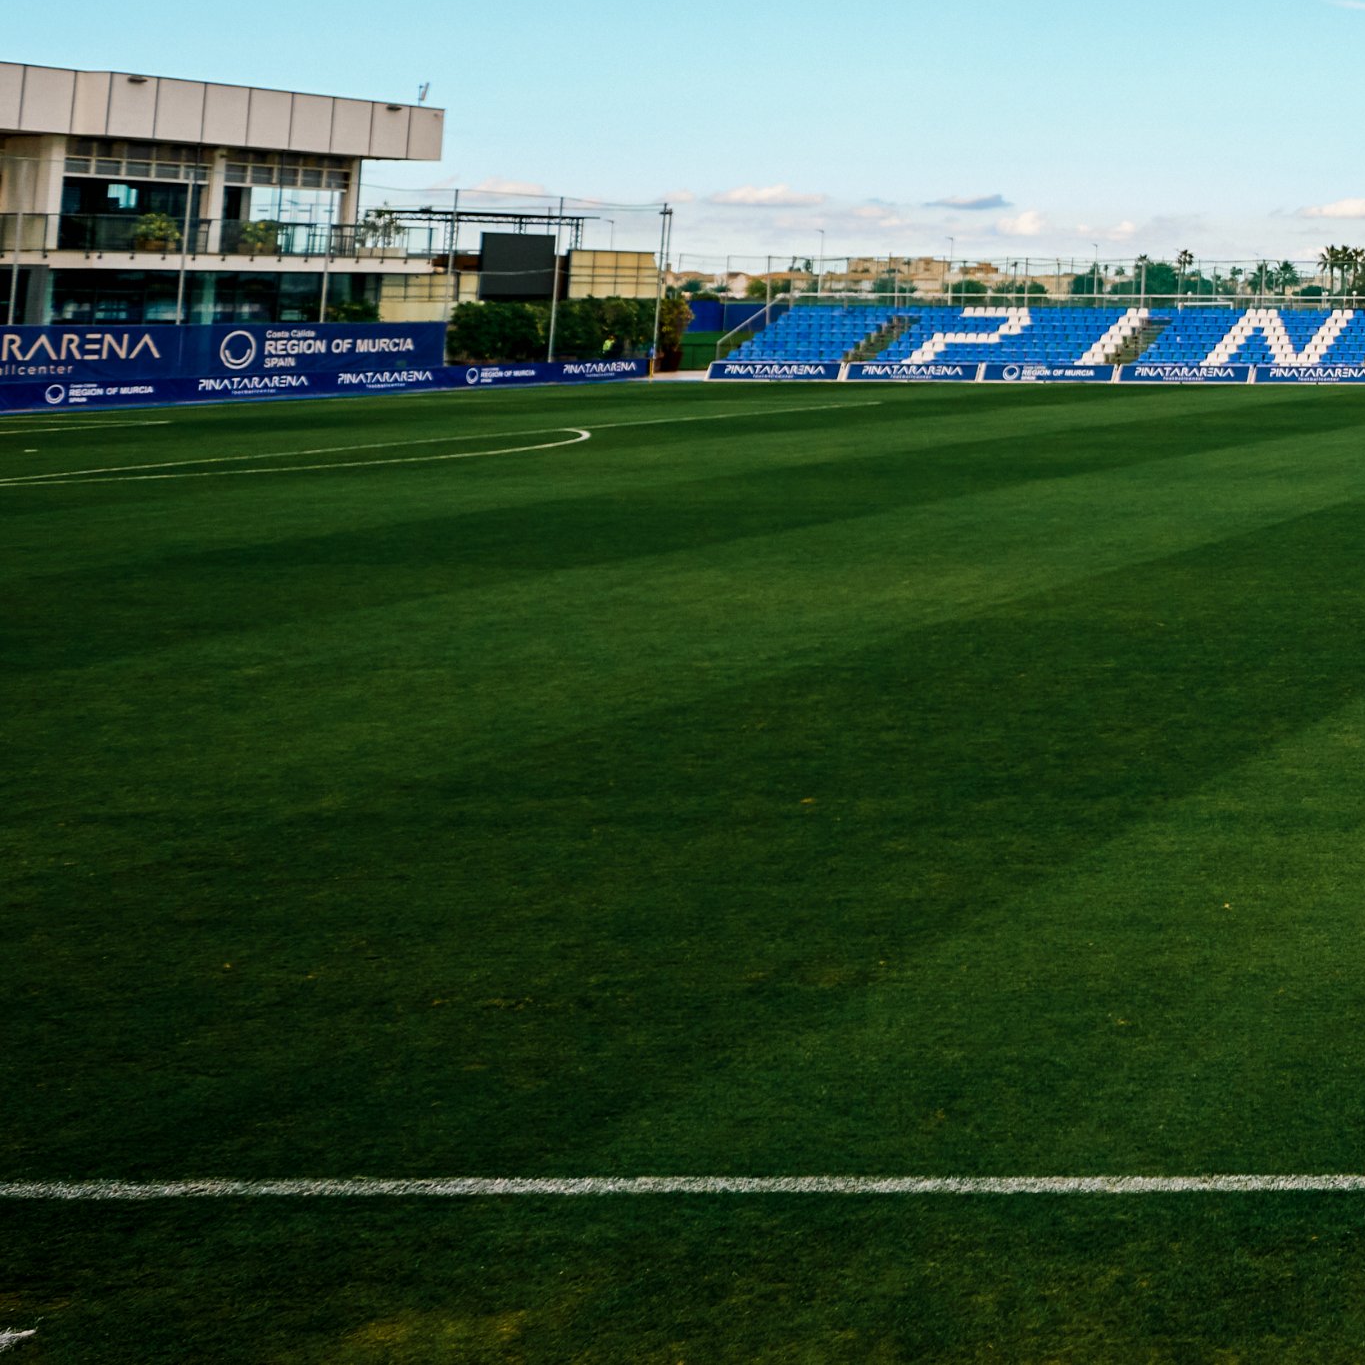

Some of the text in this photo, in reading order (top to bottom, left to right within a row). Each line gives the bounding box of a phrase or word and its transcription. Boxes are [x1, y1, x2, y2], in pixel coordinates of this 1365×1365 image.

[264, 337, 415, 355] REGION OF MURCIA
[263, 357, 296, 368] SPAIN
[563, 361, 637, 375] PINATARARENA
[724, 364, 826, 375] PINATARARENA
[862, 365, 963, 376] PINATARARENA
[1021, 369, 1095, 377] REGION OF MURCIA
[1135, 366, 1235, 378] PINATARARENA
[198, 375, 309, 391] PINATARARENA
[337, 370, 433, 385] PINATARARENA
[68, 385, 153, 397] REGION OF MURCIA
